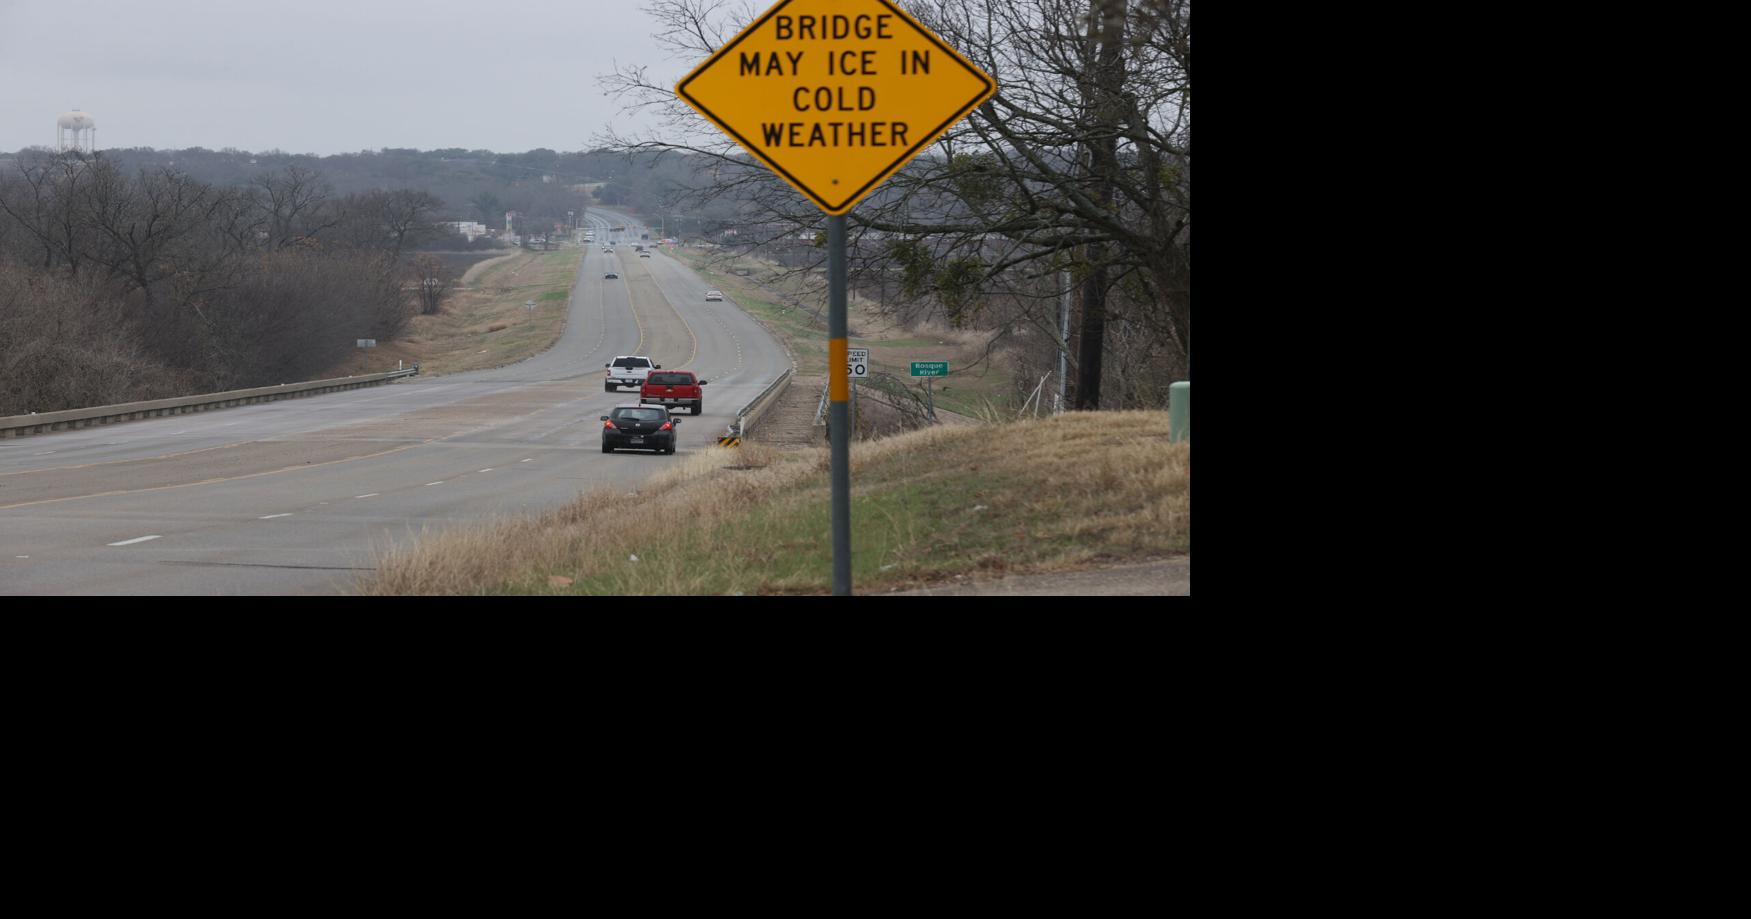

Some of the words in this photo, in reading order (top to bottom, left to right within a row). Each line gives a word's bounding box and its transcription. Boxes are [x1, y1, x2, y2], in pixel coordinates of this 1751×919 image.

[776, 14, 893, 40] BRIDGE
[739, 51, 804, 76] MAY
[828, 50, 877, 76] ICE
[901, 50, 931, 75] IN
[793, 86, 876, 112] COLD
[761, 122, 909, 147] WEATHER
